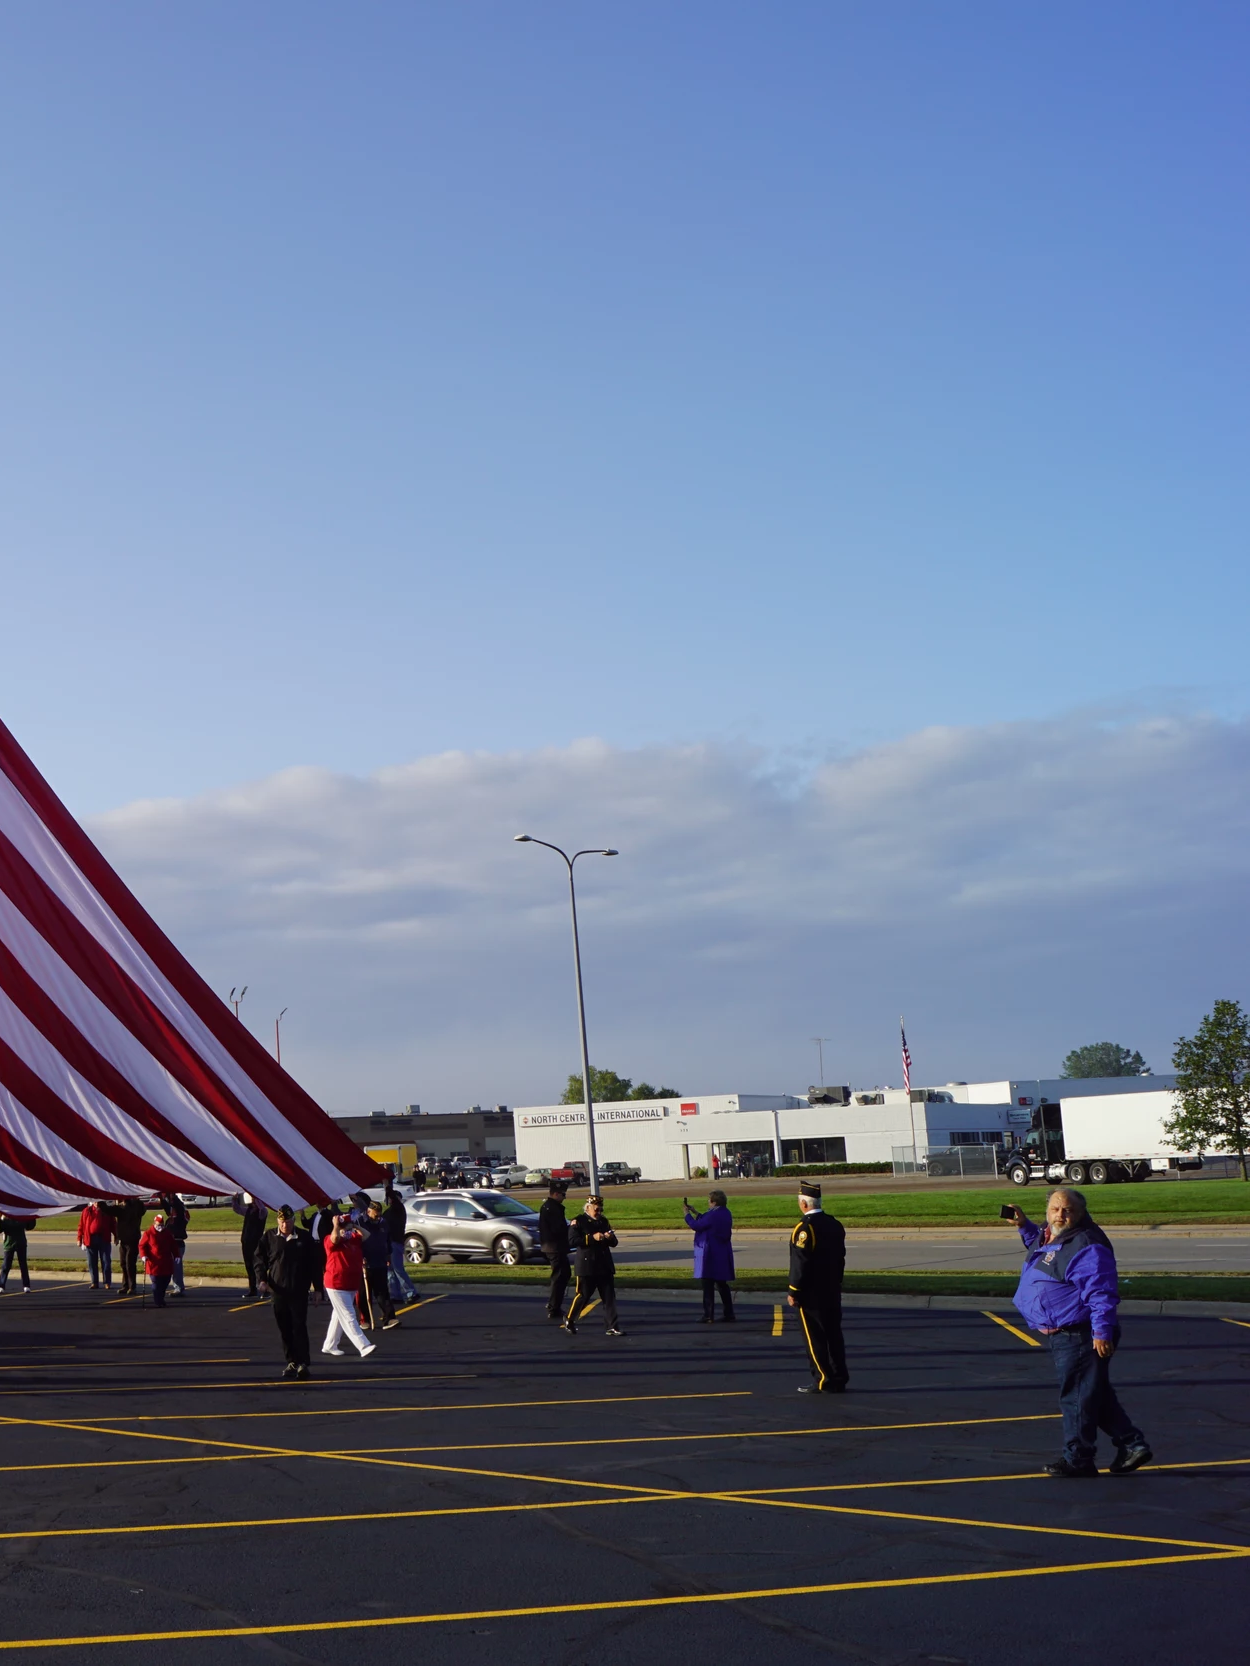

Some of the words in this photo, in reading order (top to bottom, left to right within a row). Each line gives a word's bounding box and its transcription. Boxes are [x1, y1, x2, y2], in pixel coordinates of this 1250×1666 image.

[531, 1115, 558, 1124] NORTH
[559, 1113, 595, 1123] CENTR
[597, 1108, 661, 1120] INTERNATIONAL
